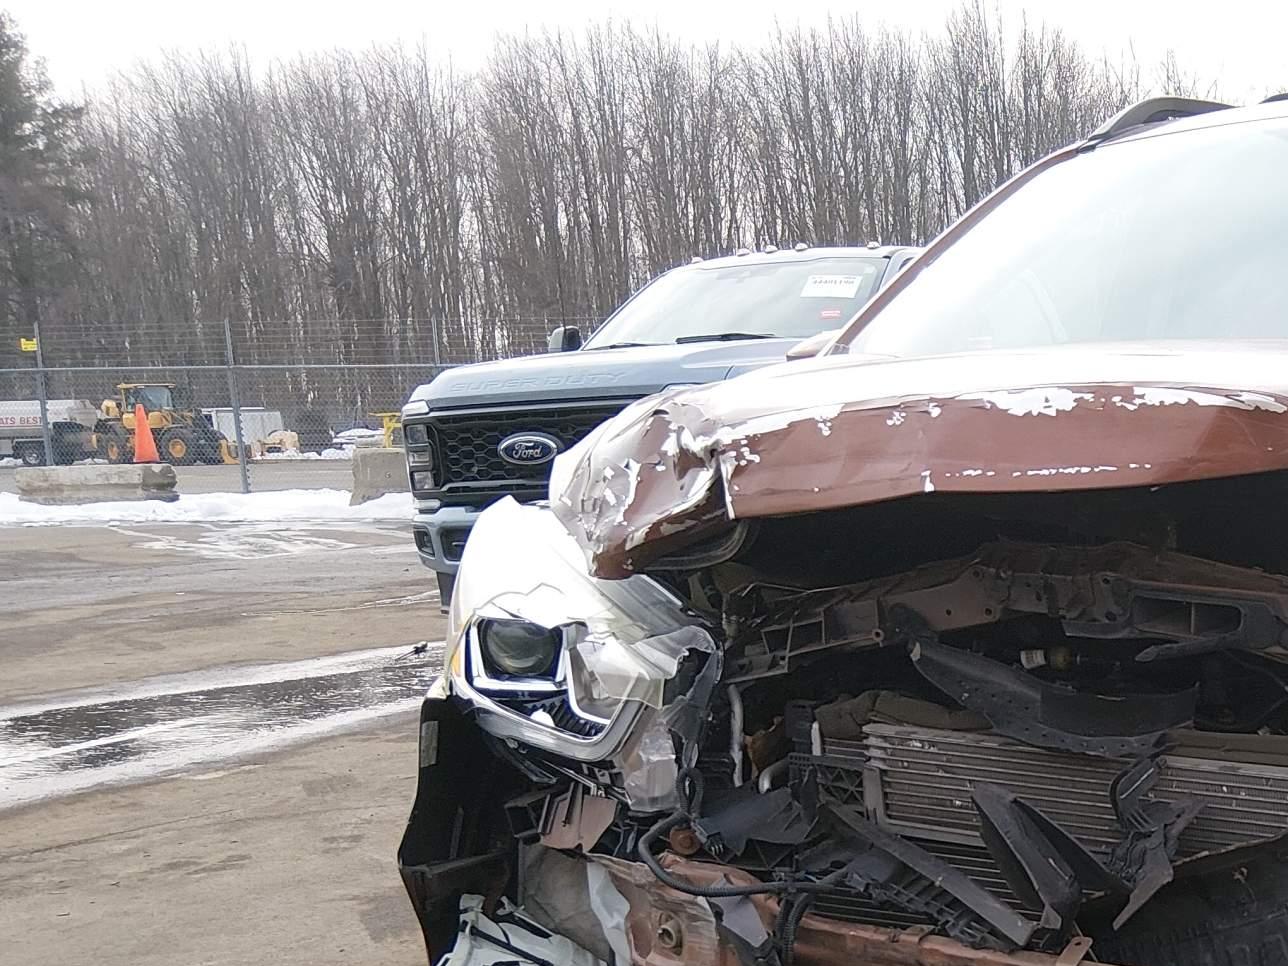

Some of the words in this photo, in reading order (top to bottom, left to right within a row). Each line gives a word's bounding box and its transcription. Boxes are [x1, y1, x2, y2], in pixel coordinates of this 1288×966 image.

[450, 376, 538, 394] SUPER
[544, 371, 628, 386] DUTY
[512, 441, 544, 460] Ford
